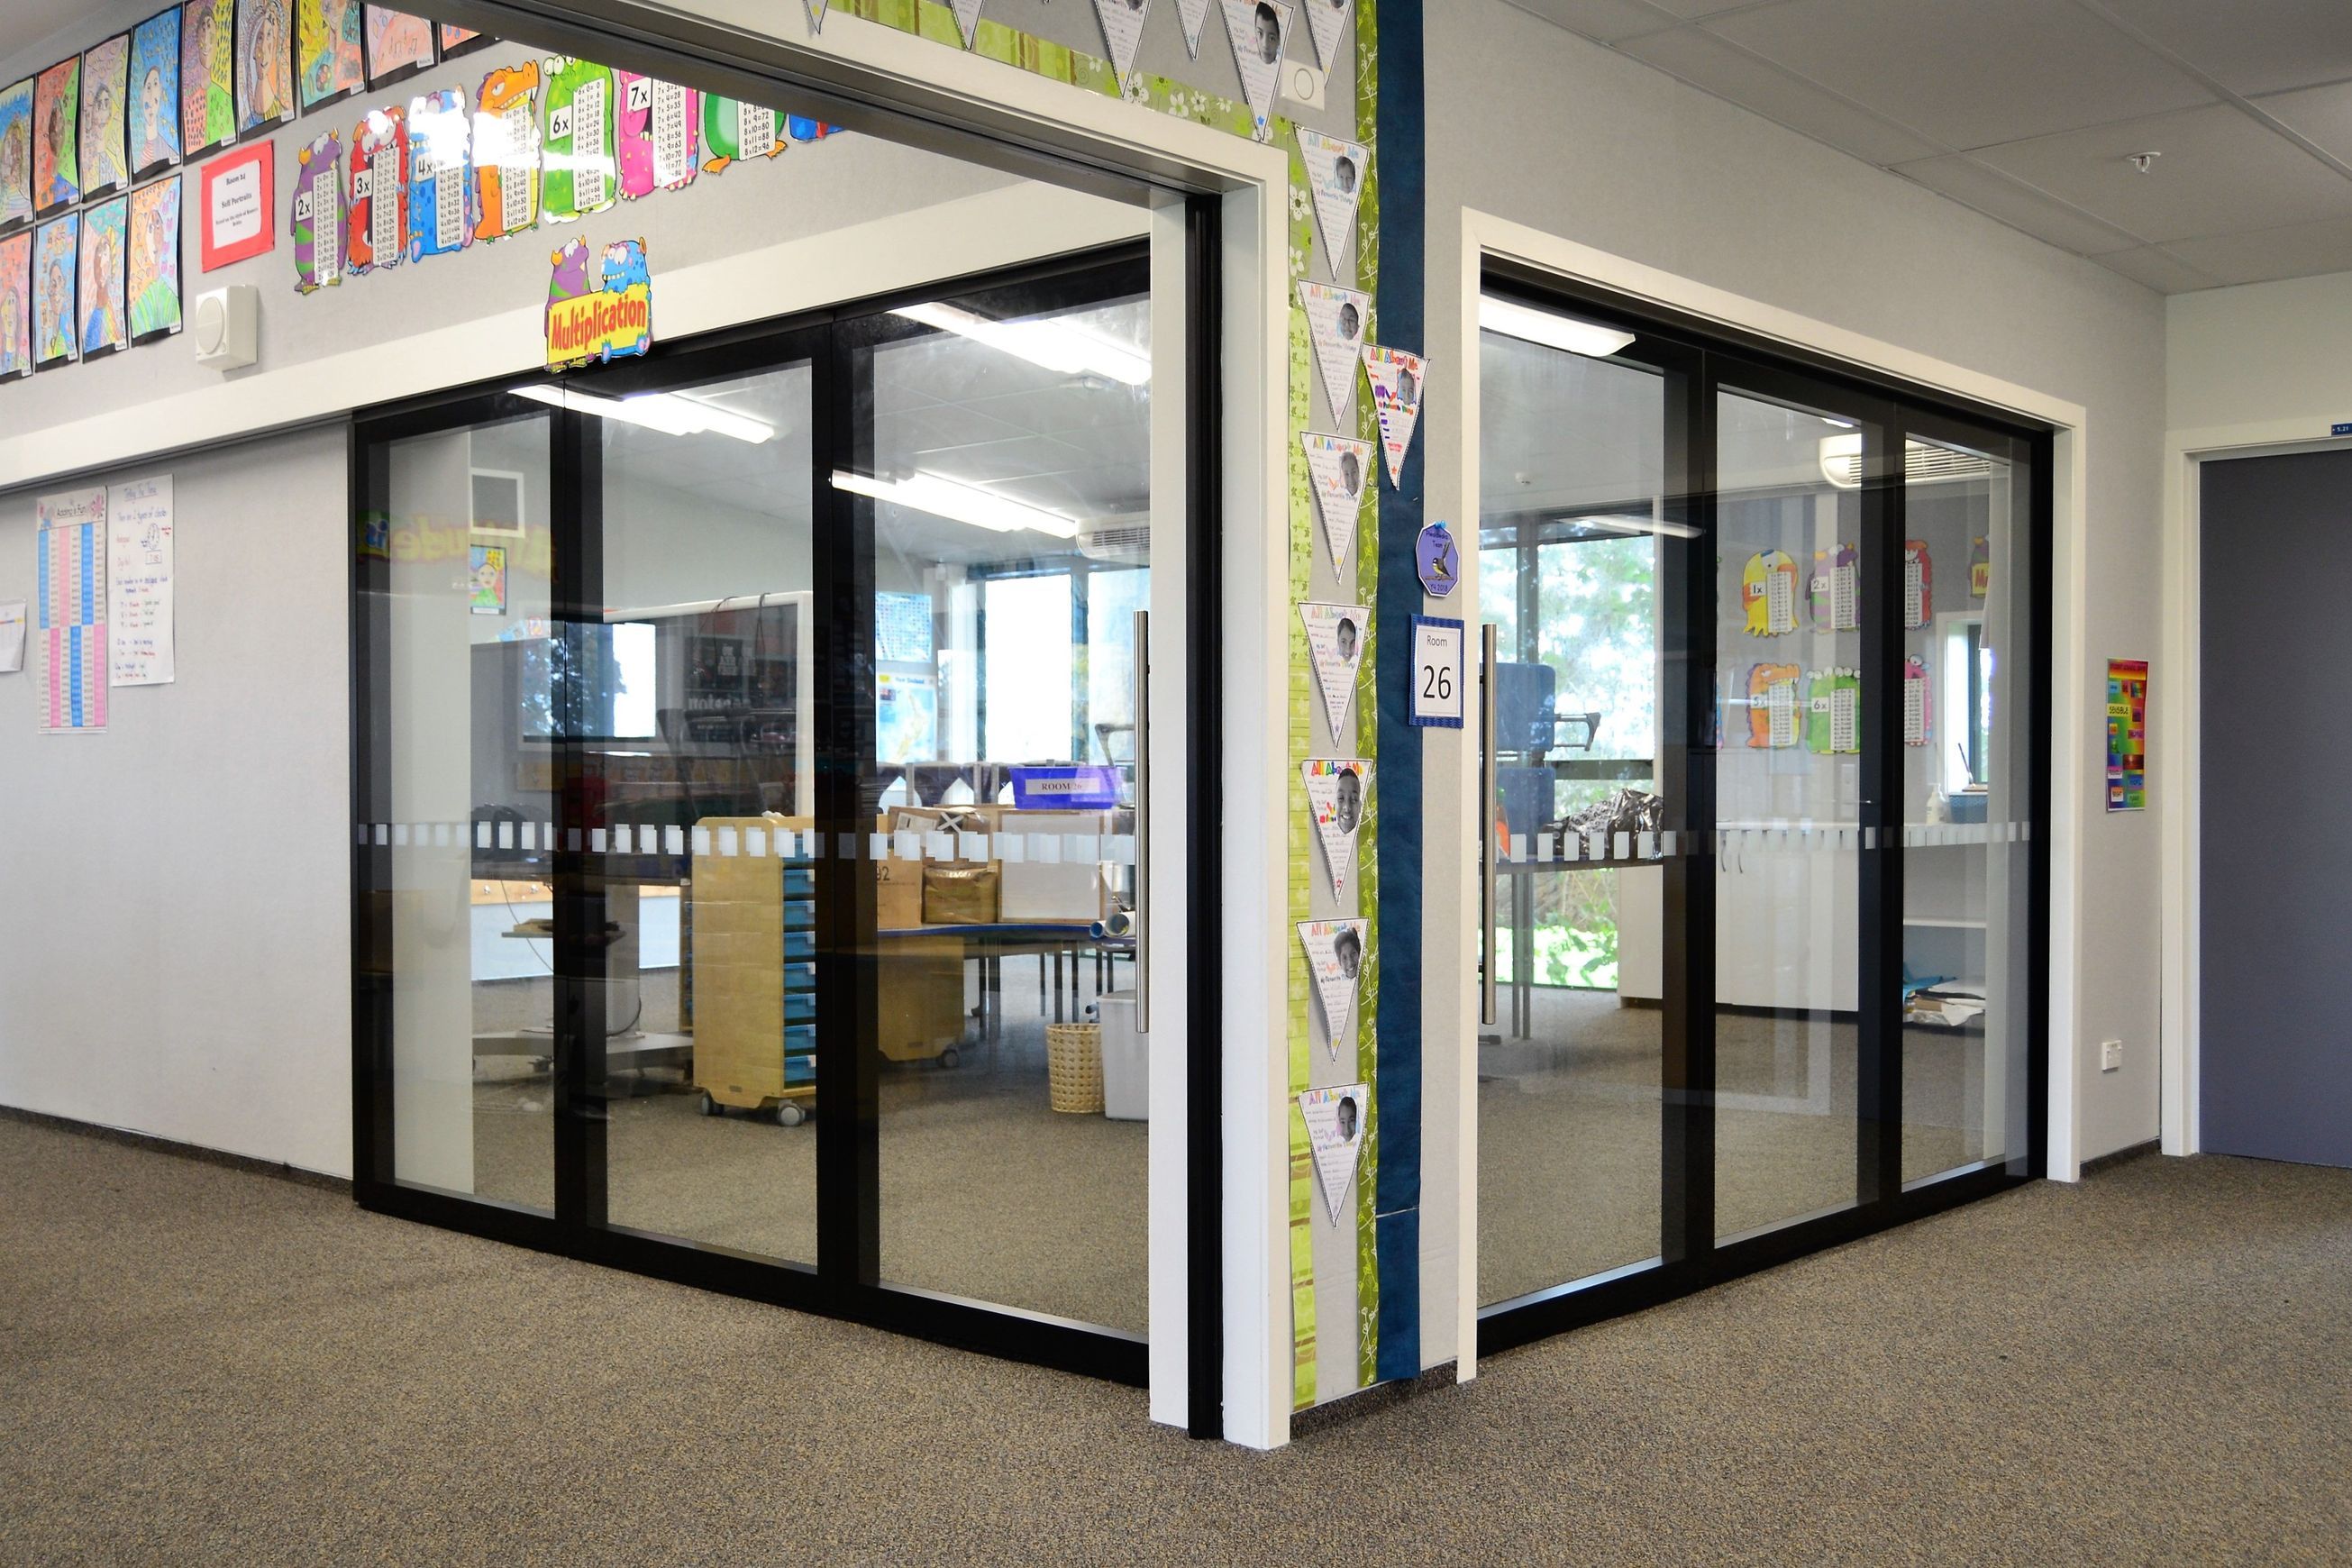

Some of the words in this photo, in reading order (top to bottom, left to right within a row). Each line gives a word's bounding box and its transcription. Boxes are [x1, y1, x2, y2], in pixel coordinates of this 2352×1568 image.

[630, 86, 648, 106] 7x
[553, 115, 569, 133] 6x
[418, 160, 433, 176] 4x
[356, 178, 369, 194] 3x
[298, 199, 310, 216] 2x
[551, 294, 646, 351] Multiplication
[1753, 584, 1763, 594] 1x
[1813, 579, 1827, 589] 2x
[1427, 634, 1448, 647] Room
[1423, 665, 1451, 699] 26
[1814, 700, 1827, 710] 6x
[1326, 761, 1351, 776] Abot
[1042, 782, 1071, 791] ROOM
